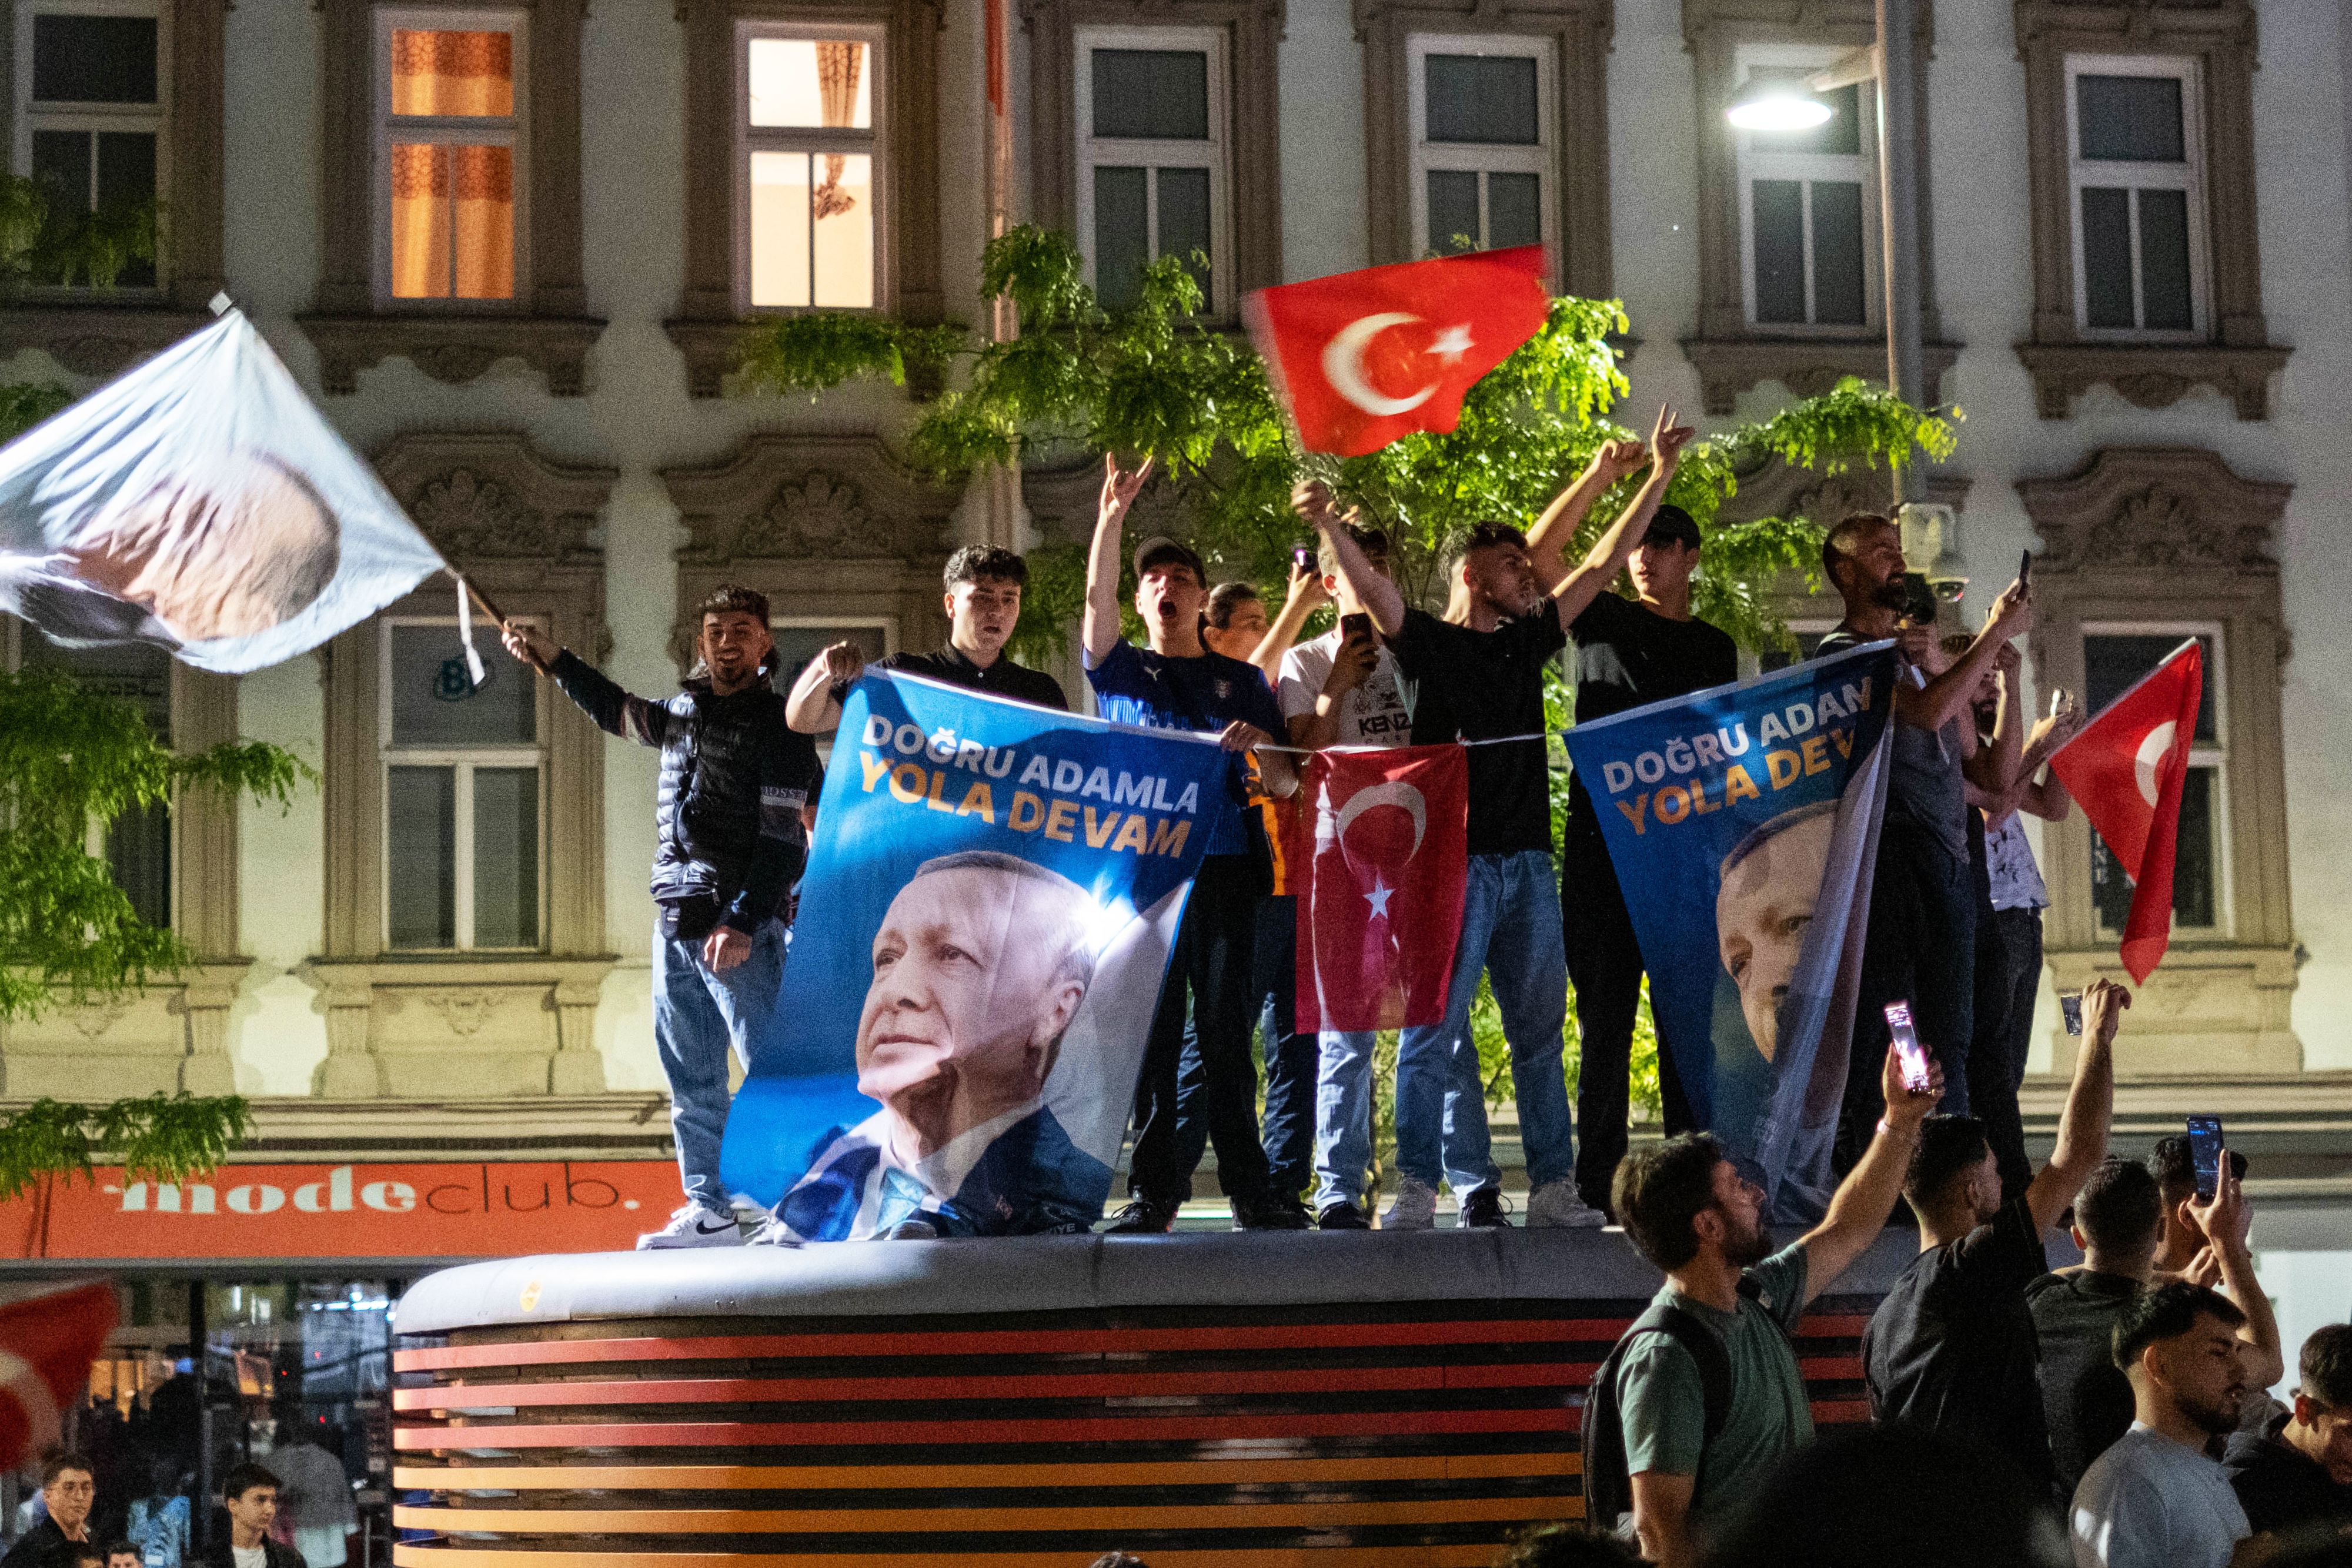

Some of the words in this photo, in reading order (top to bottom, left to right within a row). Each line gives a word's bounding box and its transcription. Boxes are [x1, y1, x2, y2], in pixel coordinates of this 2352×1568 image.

[861, 713, 1016, 778] DOĞRU
[1019, 755, 1200, 814] ADAMLA
[1602, 723, 1750, 794] DOĞRU
[1615, 764, 1760, 835] YOLA
[858, 751, 995, 824] YOLA
[1008, 791, 1192, 858] DEVAM
